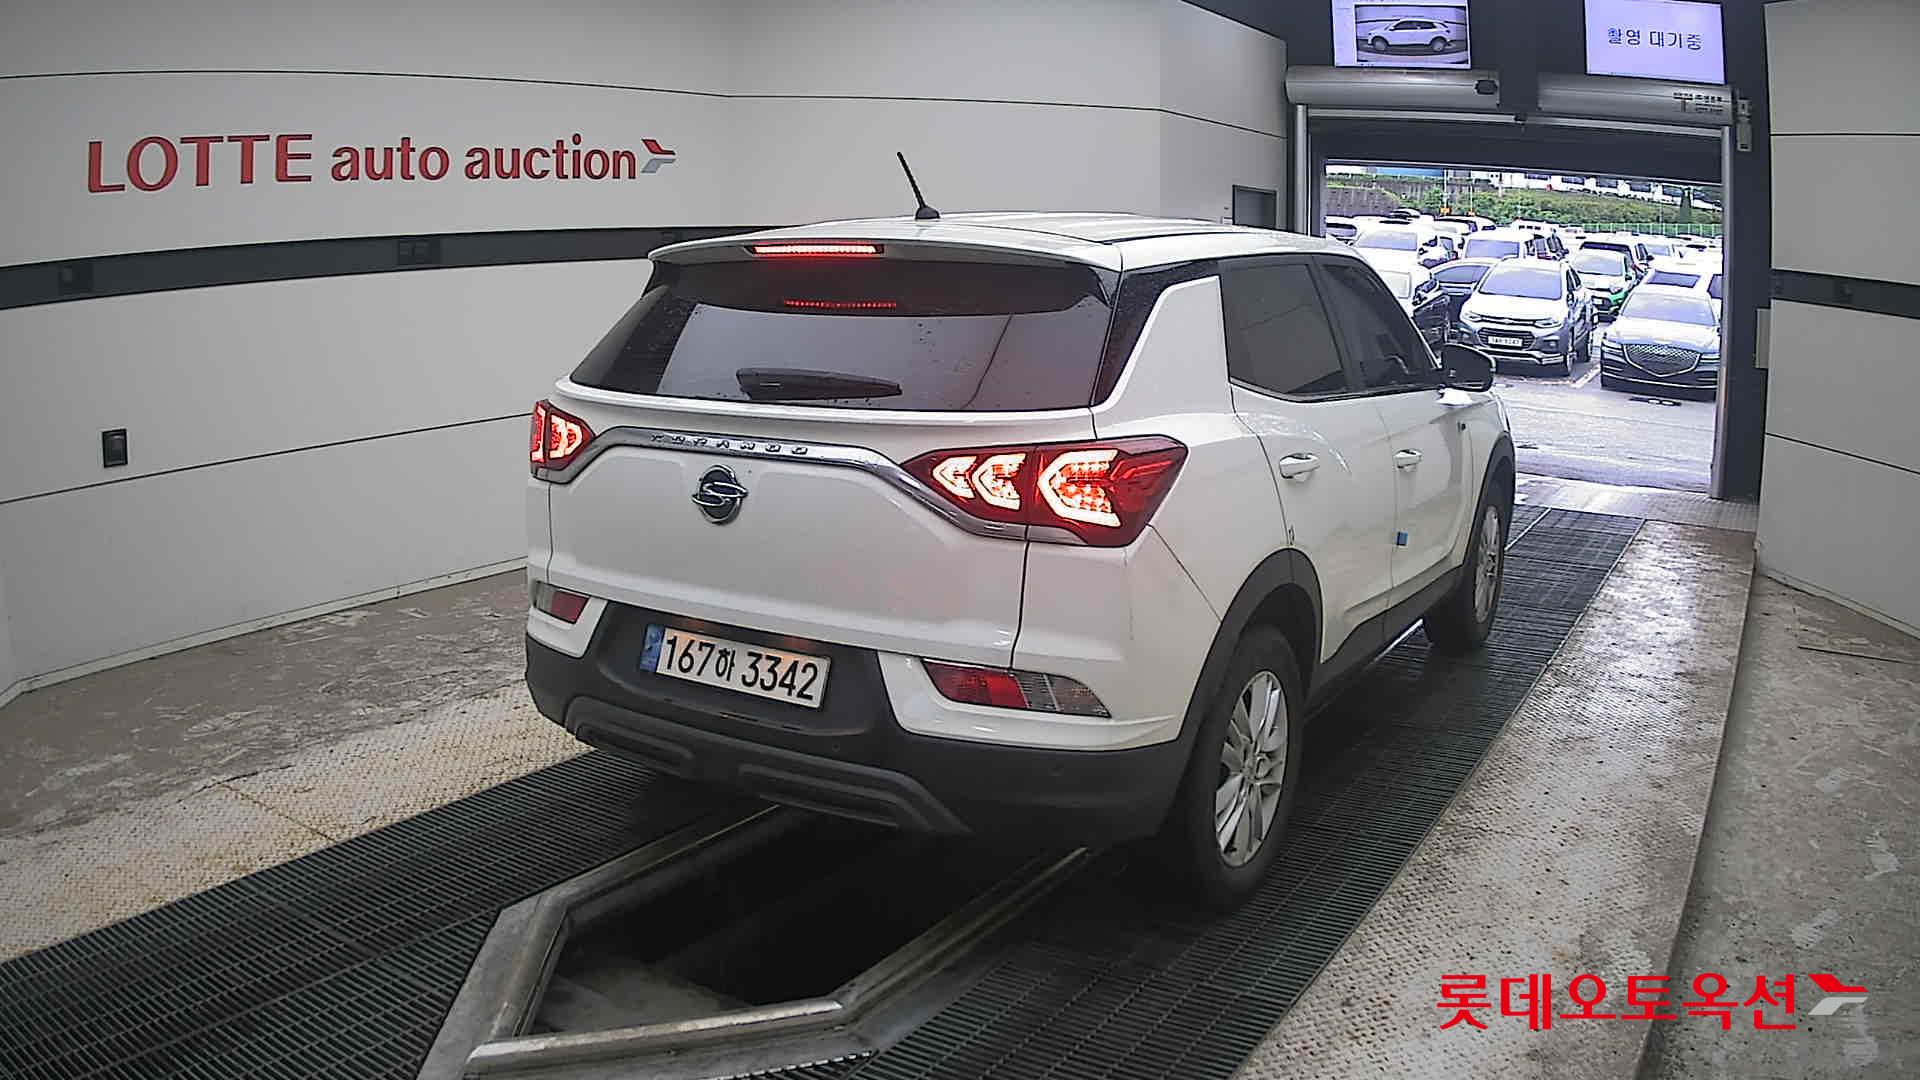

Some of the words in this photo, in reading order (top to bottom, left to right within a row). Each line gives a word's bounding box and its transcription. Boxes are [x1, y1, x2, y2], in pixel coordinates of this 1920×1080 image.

[1649, 31, 1702, 51] 대기중
[87, 133, 313, 194] LOTTE
[330, 137, 450, 182] auto
[463, 133, 638, 181] auction
[666, 635, 736, 682] 167하
[741, 651, 819, 701] 3342
